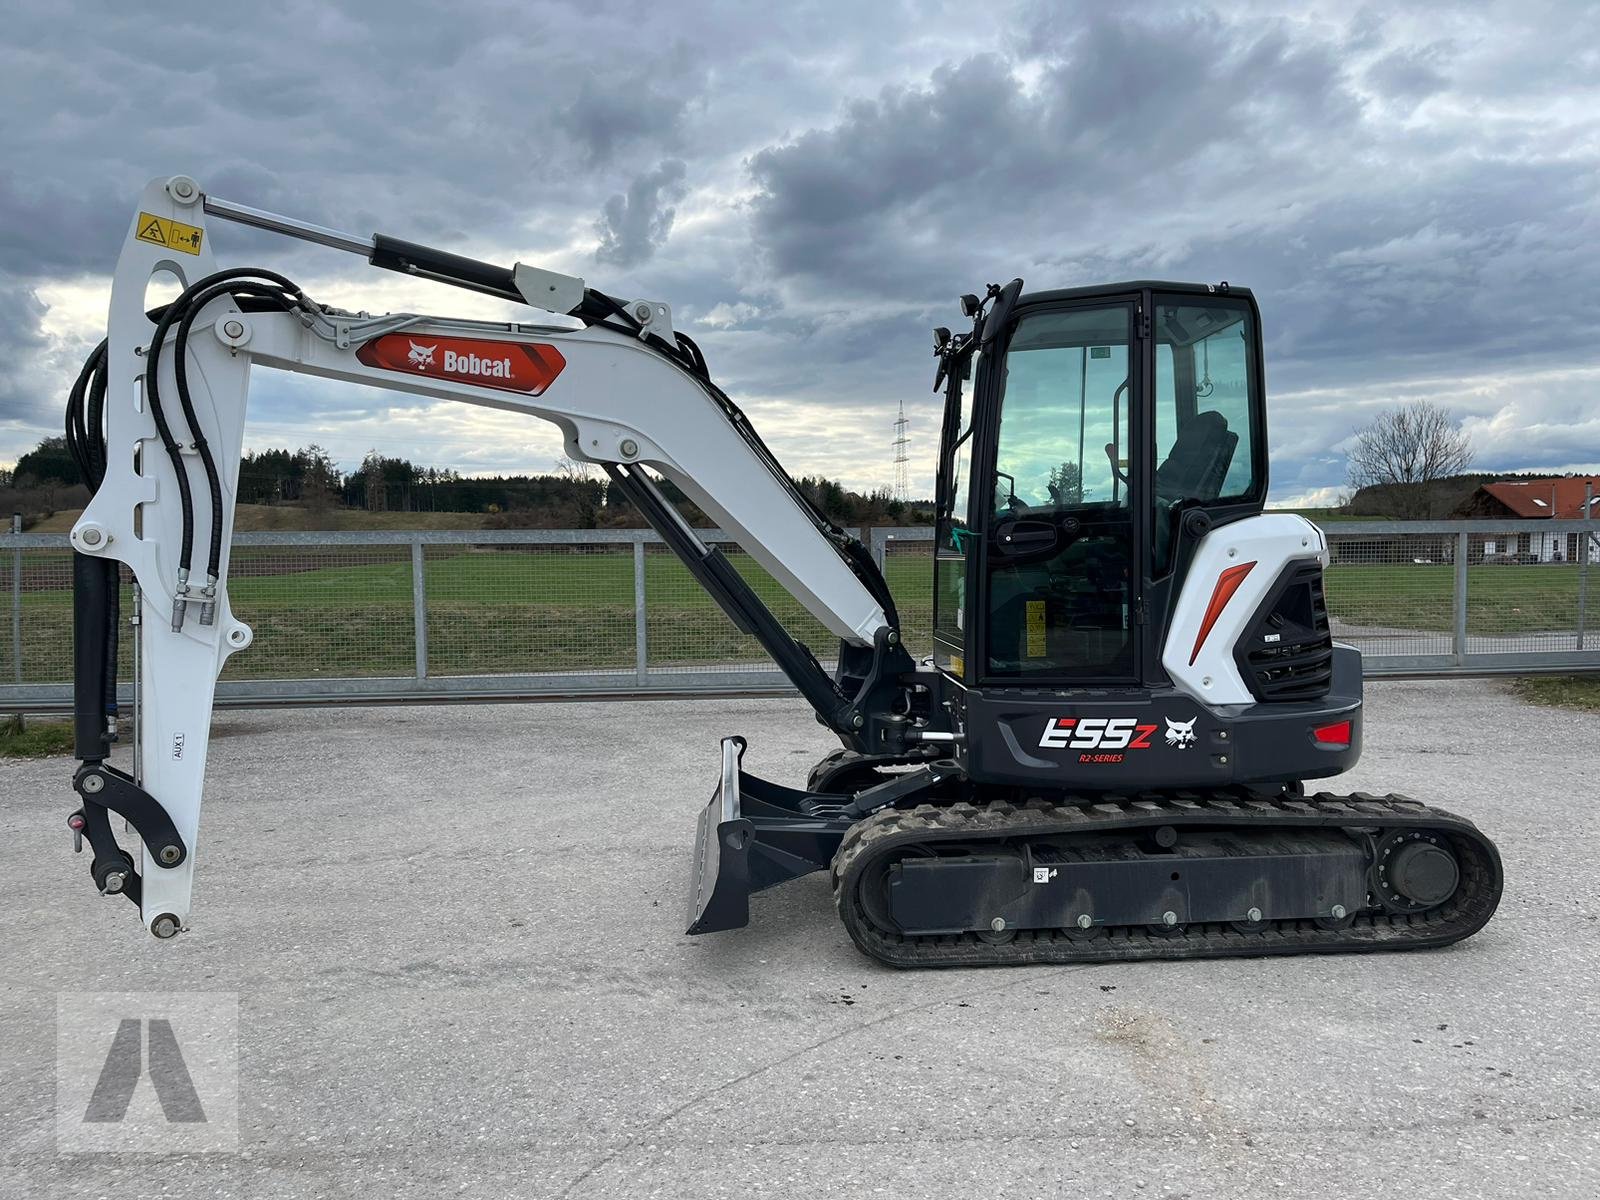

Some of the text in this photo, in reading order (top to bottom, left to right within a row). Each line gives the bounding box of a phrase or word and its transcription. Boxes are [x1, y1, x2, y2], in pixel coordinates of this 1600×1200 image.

[444, 350, 511, 378] Bobcat
[174, 741, 182, 758] AUX
[1078, 753, 1124, 763] R2-SERIES
